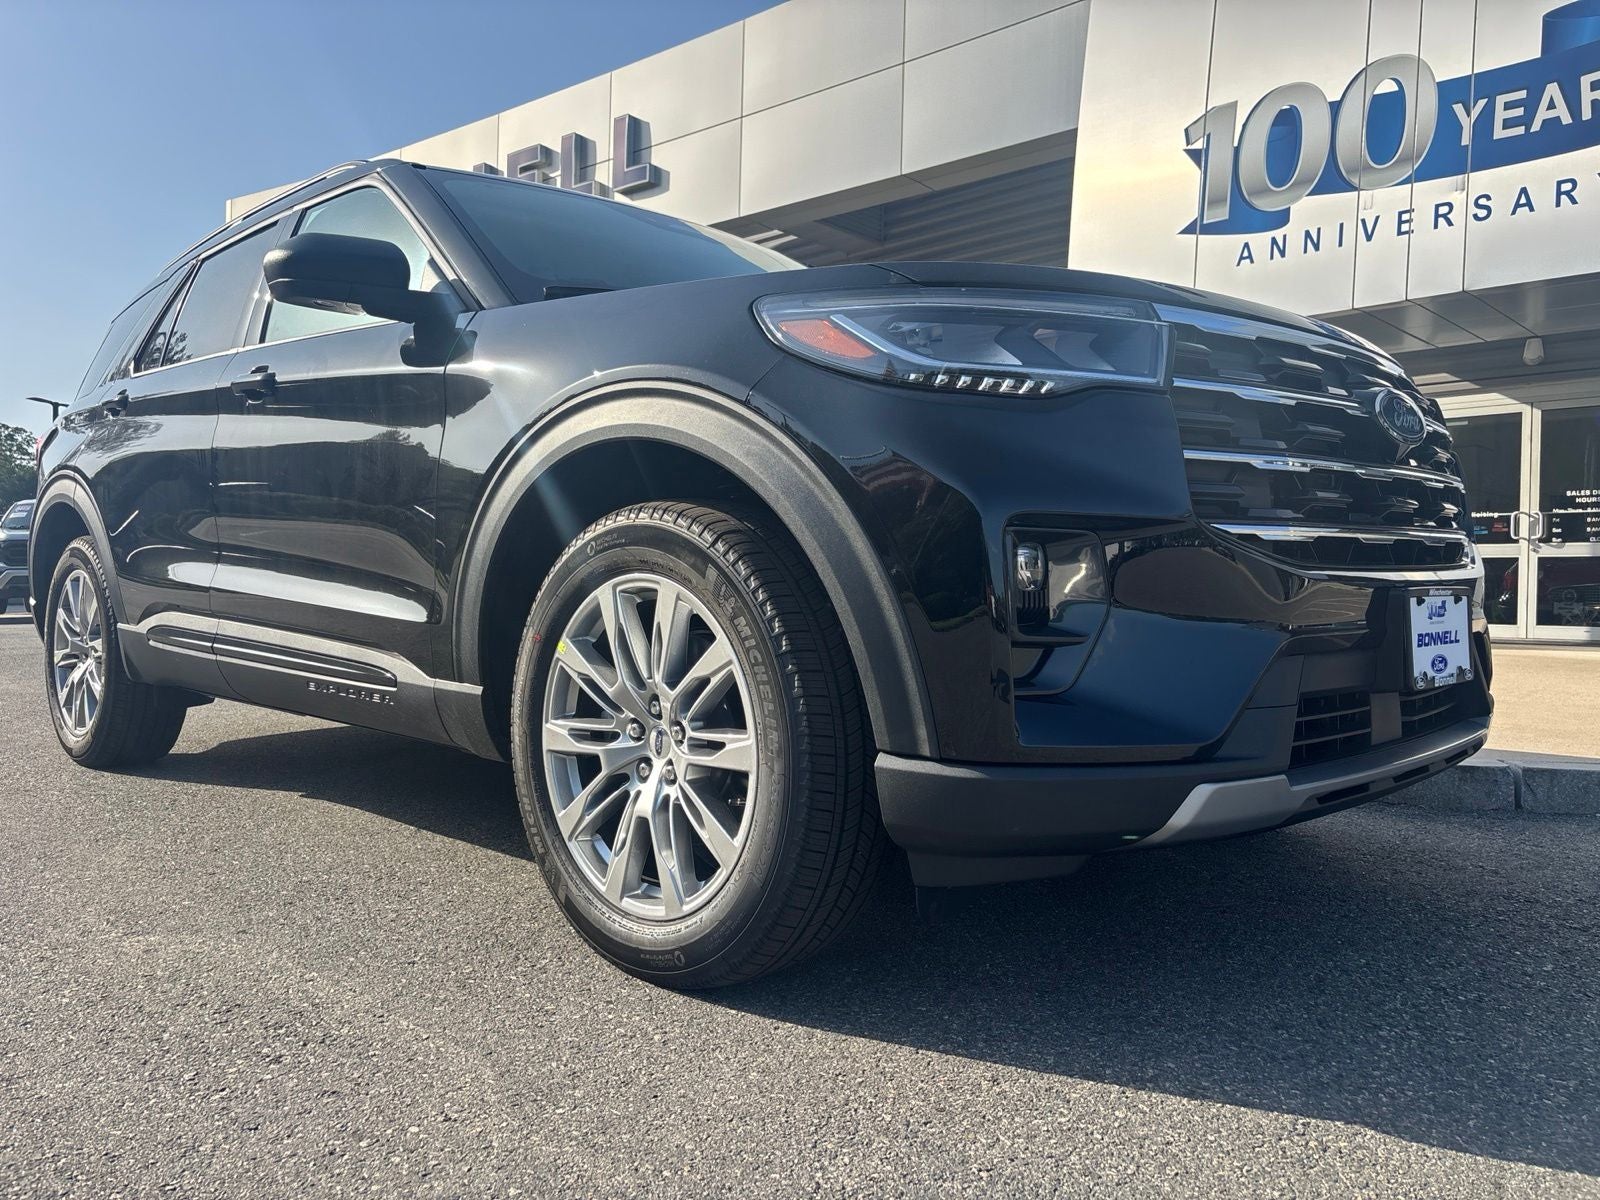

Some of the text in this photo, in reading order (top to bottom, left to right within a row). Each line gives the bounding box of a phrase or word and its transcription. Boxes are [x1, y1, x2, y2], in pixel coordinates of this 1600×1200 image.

[1184, 54, 1438, 224] 100
[1236, 172, 1600, 267] ANNIVERSAR
[733, 614, 782, 758] MICHELIN
[1417, 630, 1460, 648] BONNELL
[308, 681, 394, 705] EXPLORER
